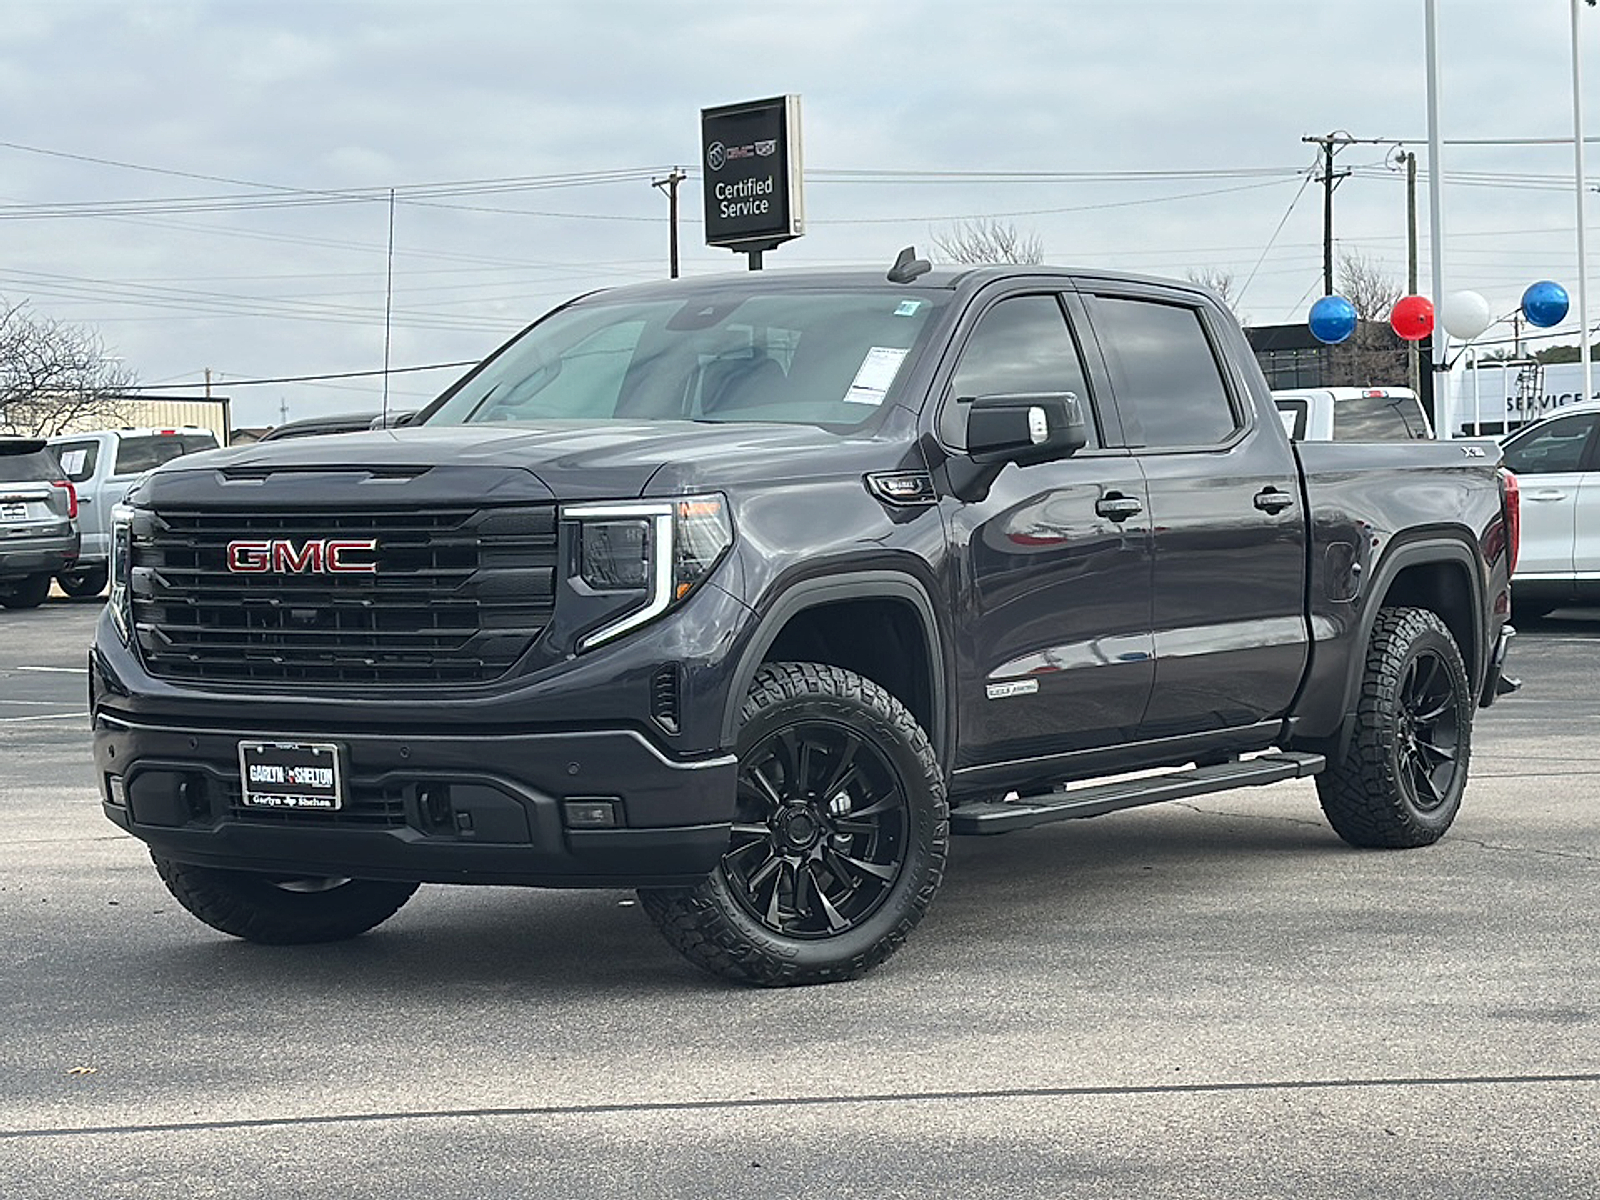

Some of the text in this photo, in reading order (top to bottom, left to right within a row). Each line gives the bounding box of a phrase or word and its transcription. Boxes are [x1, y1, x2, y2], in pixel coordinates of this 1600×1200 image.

[715, 175, 774, 200] Certified
[720, 198, 770, 219] Service
[226, 538, 378, 575] GMC
[249, 765, 333, 785] GARLYN SHELTON
